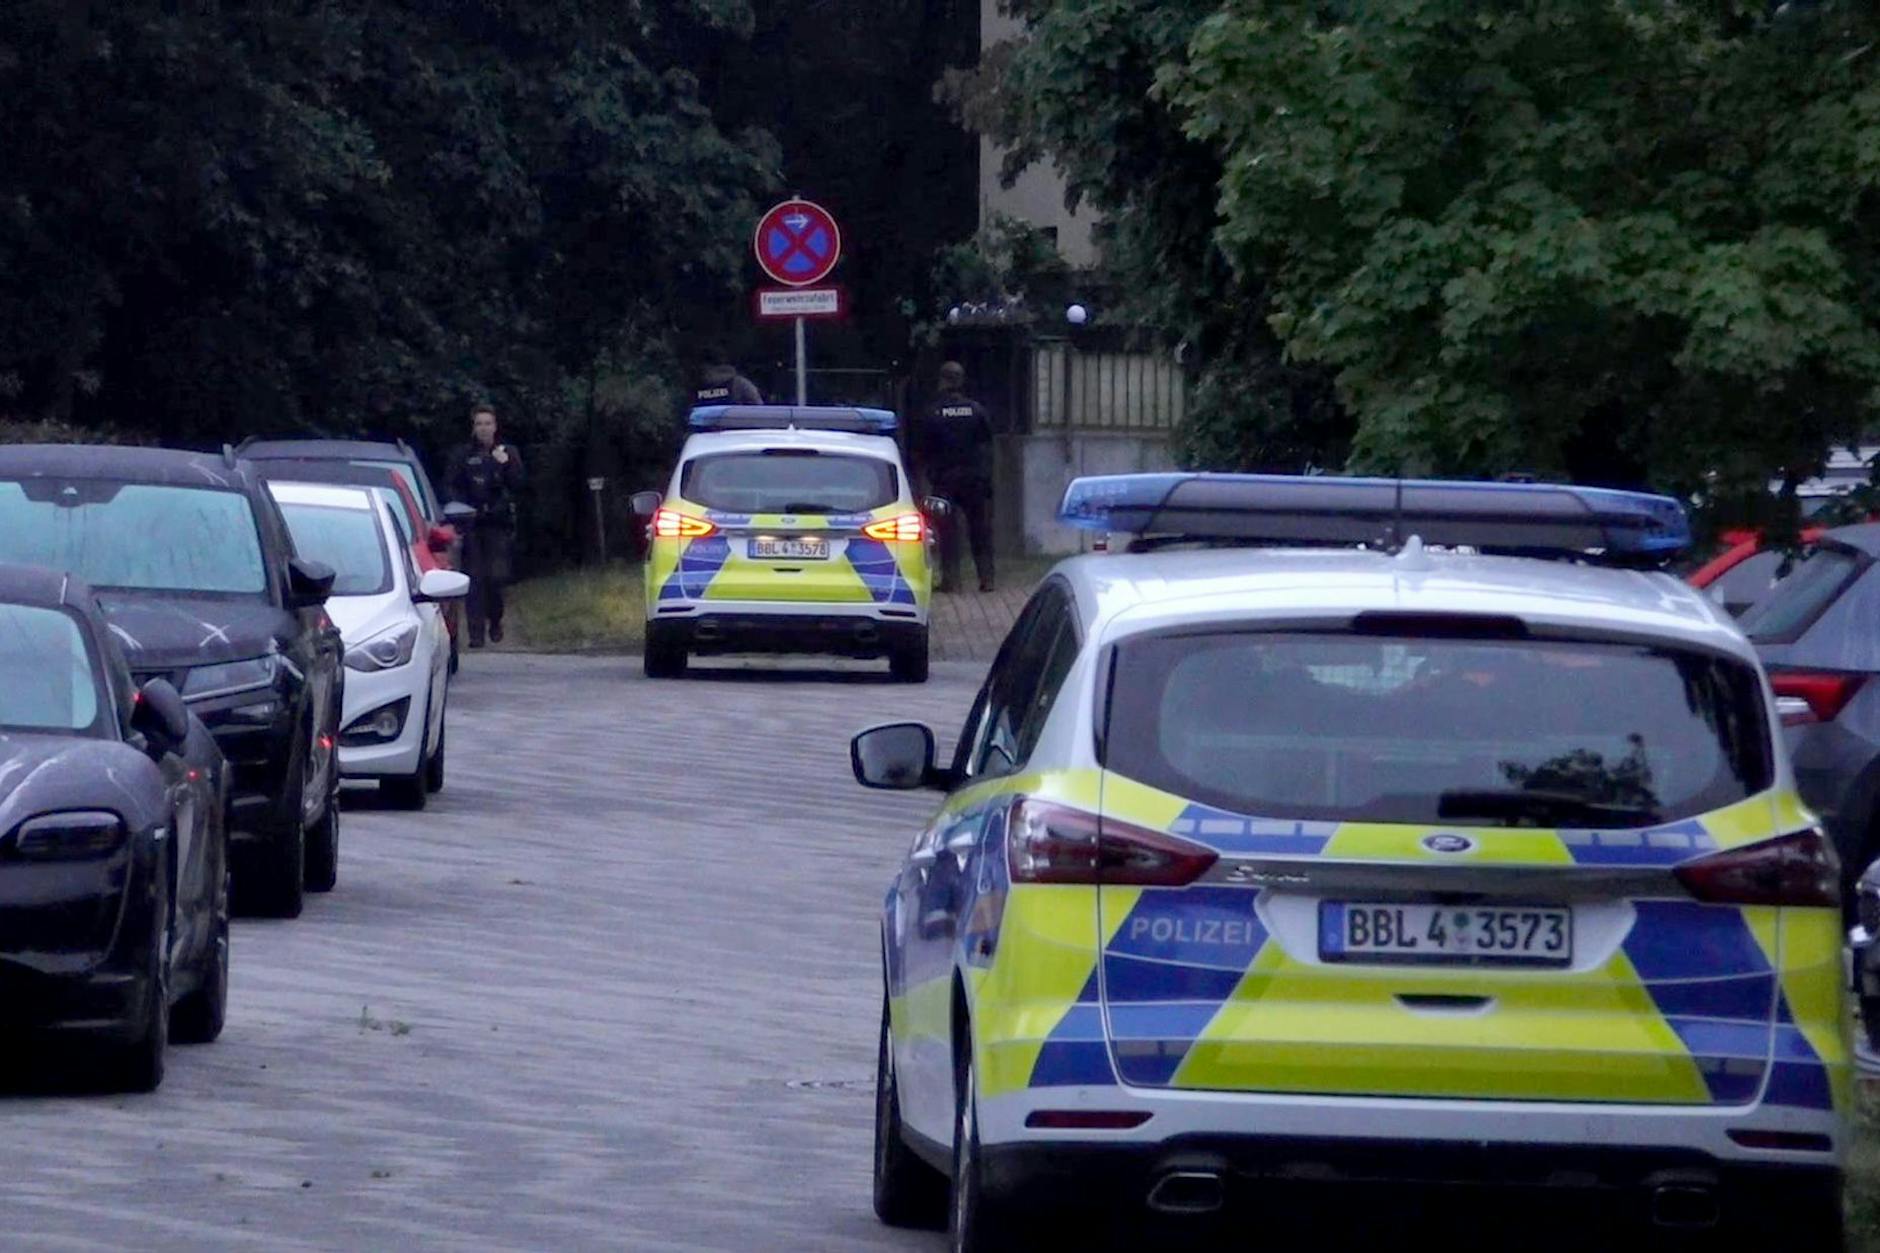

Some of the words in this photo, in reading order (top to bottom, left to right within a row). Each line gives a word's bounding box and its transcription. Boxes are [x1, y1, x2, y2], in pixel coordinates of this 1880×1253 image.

[697, 387, 728, 399] POLIZEI
[942, 406, 973, 418] POLIZEI
[1130, 916, 1253, 945] POLIZEI
[1348, 908, 1417, 948] BBL
[1427, 910, 1447, 949] 4
[1475, 911, 1564, 951] 3573
